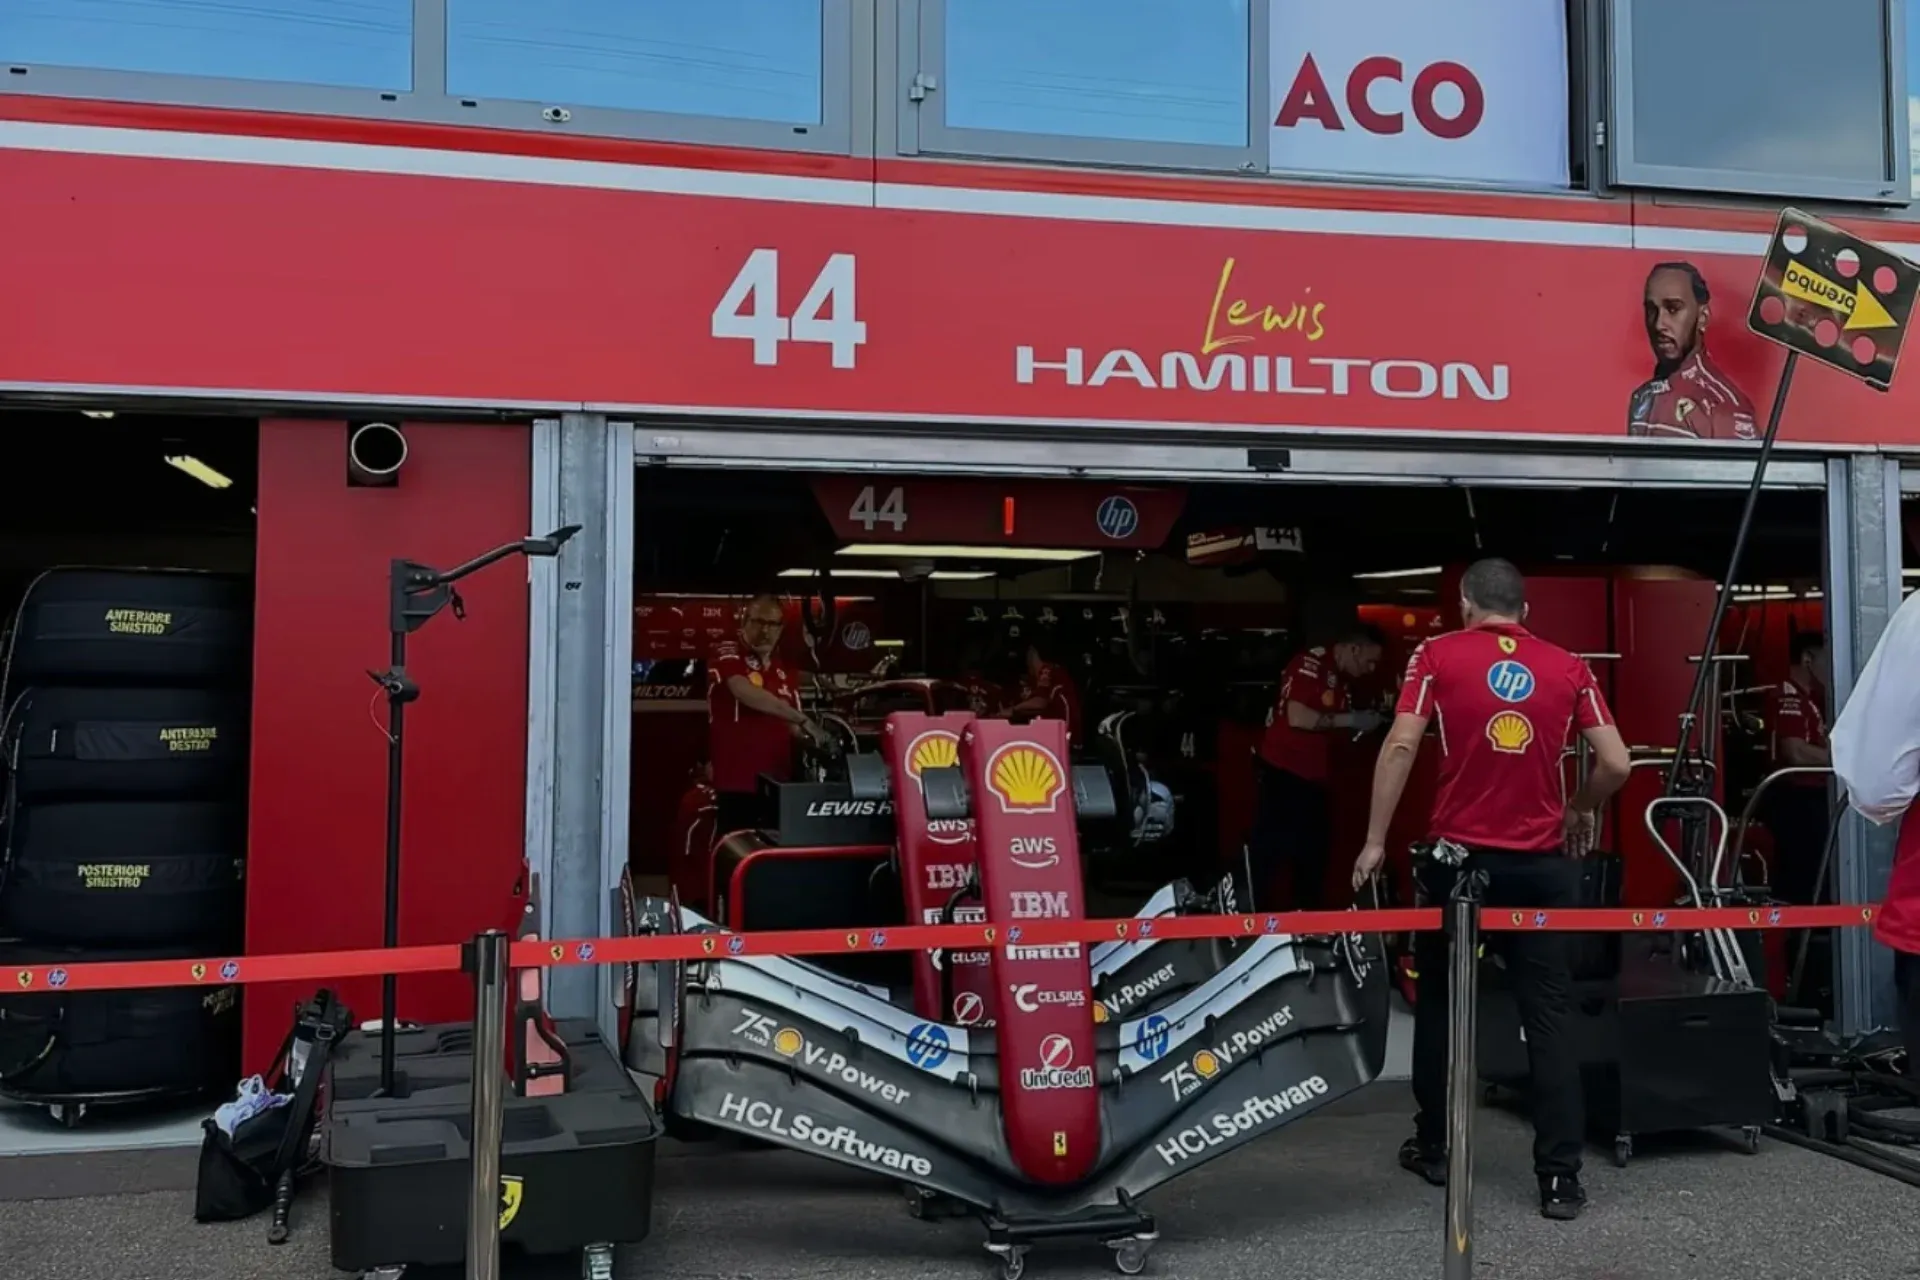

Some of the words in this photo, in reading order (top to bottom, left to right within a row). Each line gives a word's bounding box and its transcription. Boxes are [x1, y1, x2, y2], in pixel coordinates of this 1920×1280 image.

[1274, 52, 1484, 139] ACO
[711, 248, 867, 369] 44
[1202, 257, 1326, 355] Lewis
[1786, 269, 1857, 314] brembo
[1016, 345, 1509, 401] HAMILTON
[849, 485, 907, 532] 44
[1098, 496, 1137, 539] hp
[105, 608, 172, 624] ANTERIORE
[110, 621, 165, 635] SINISTRO
[1490, 660, 1533, 701] hp
[807, 801, 877, 817] LEWIS
[928, 818, 968, 833] aws
[1010, 837, 1056, 855] aws
[78, 864, 150, 877] POSTERIORE
[85, 877, 141, 888] SINISTRO
[926, 864, 975, 889] IBM
[924, 907, 987, 925] PIELLI
[1010, 892, 1069, 919] IBM
[1006, 942, 1080, 960] PIRELLI
[1038, 990, 1085, 1003] CELSIUS
[1104, 963, 1177, 1015] V-Power
[732, 1007, 778, 1040] 75
[1135, 1014, 1169, 1060] hp
[1213, 1004, 1295, 1065] V-Power
[907, 1022, 950, 1070] hp
[802, 1040, 910, 1105] V-Power
[1022, 1067, 1093, 1089] UniCredit
[1160, 1060, 1198, 1102] 75
[718, 1092, 932, 1176] HCLSoftware
[1156, 1074, 1329, 1166] HCLSoftware
